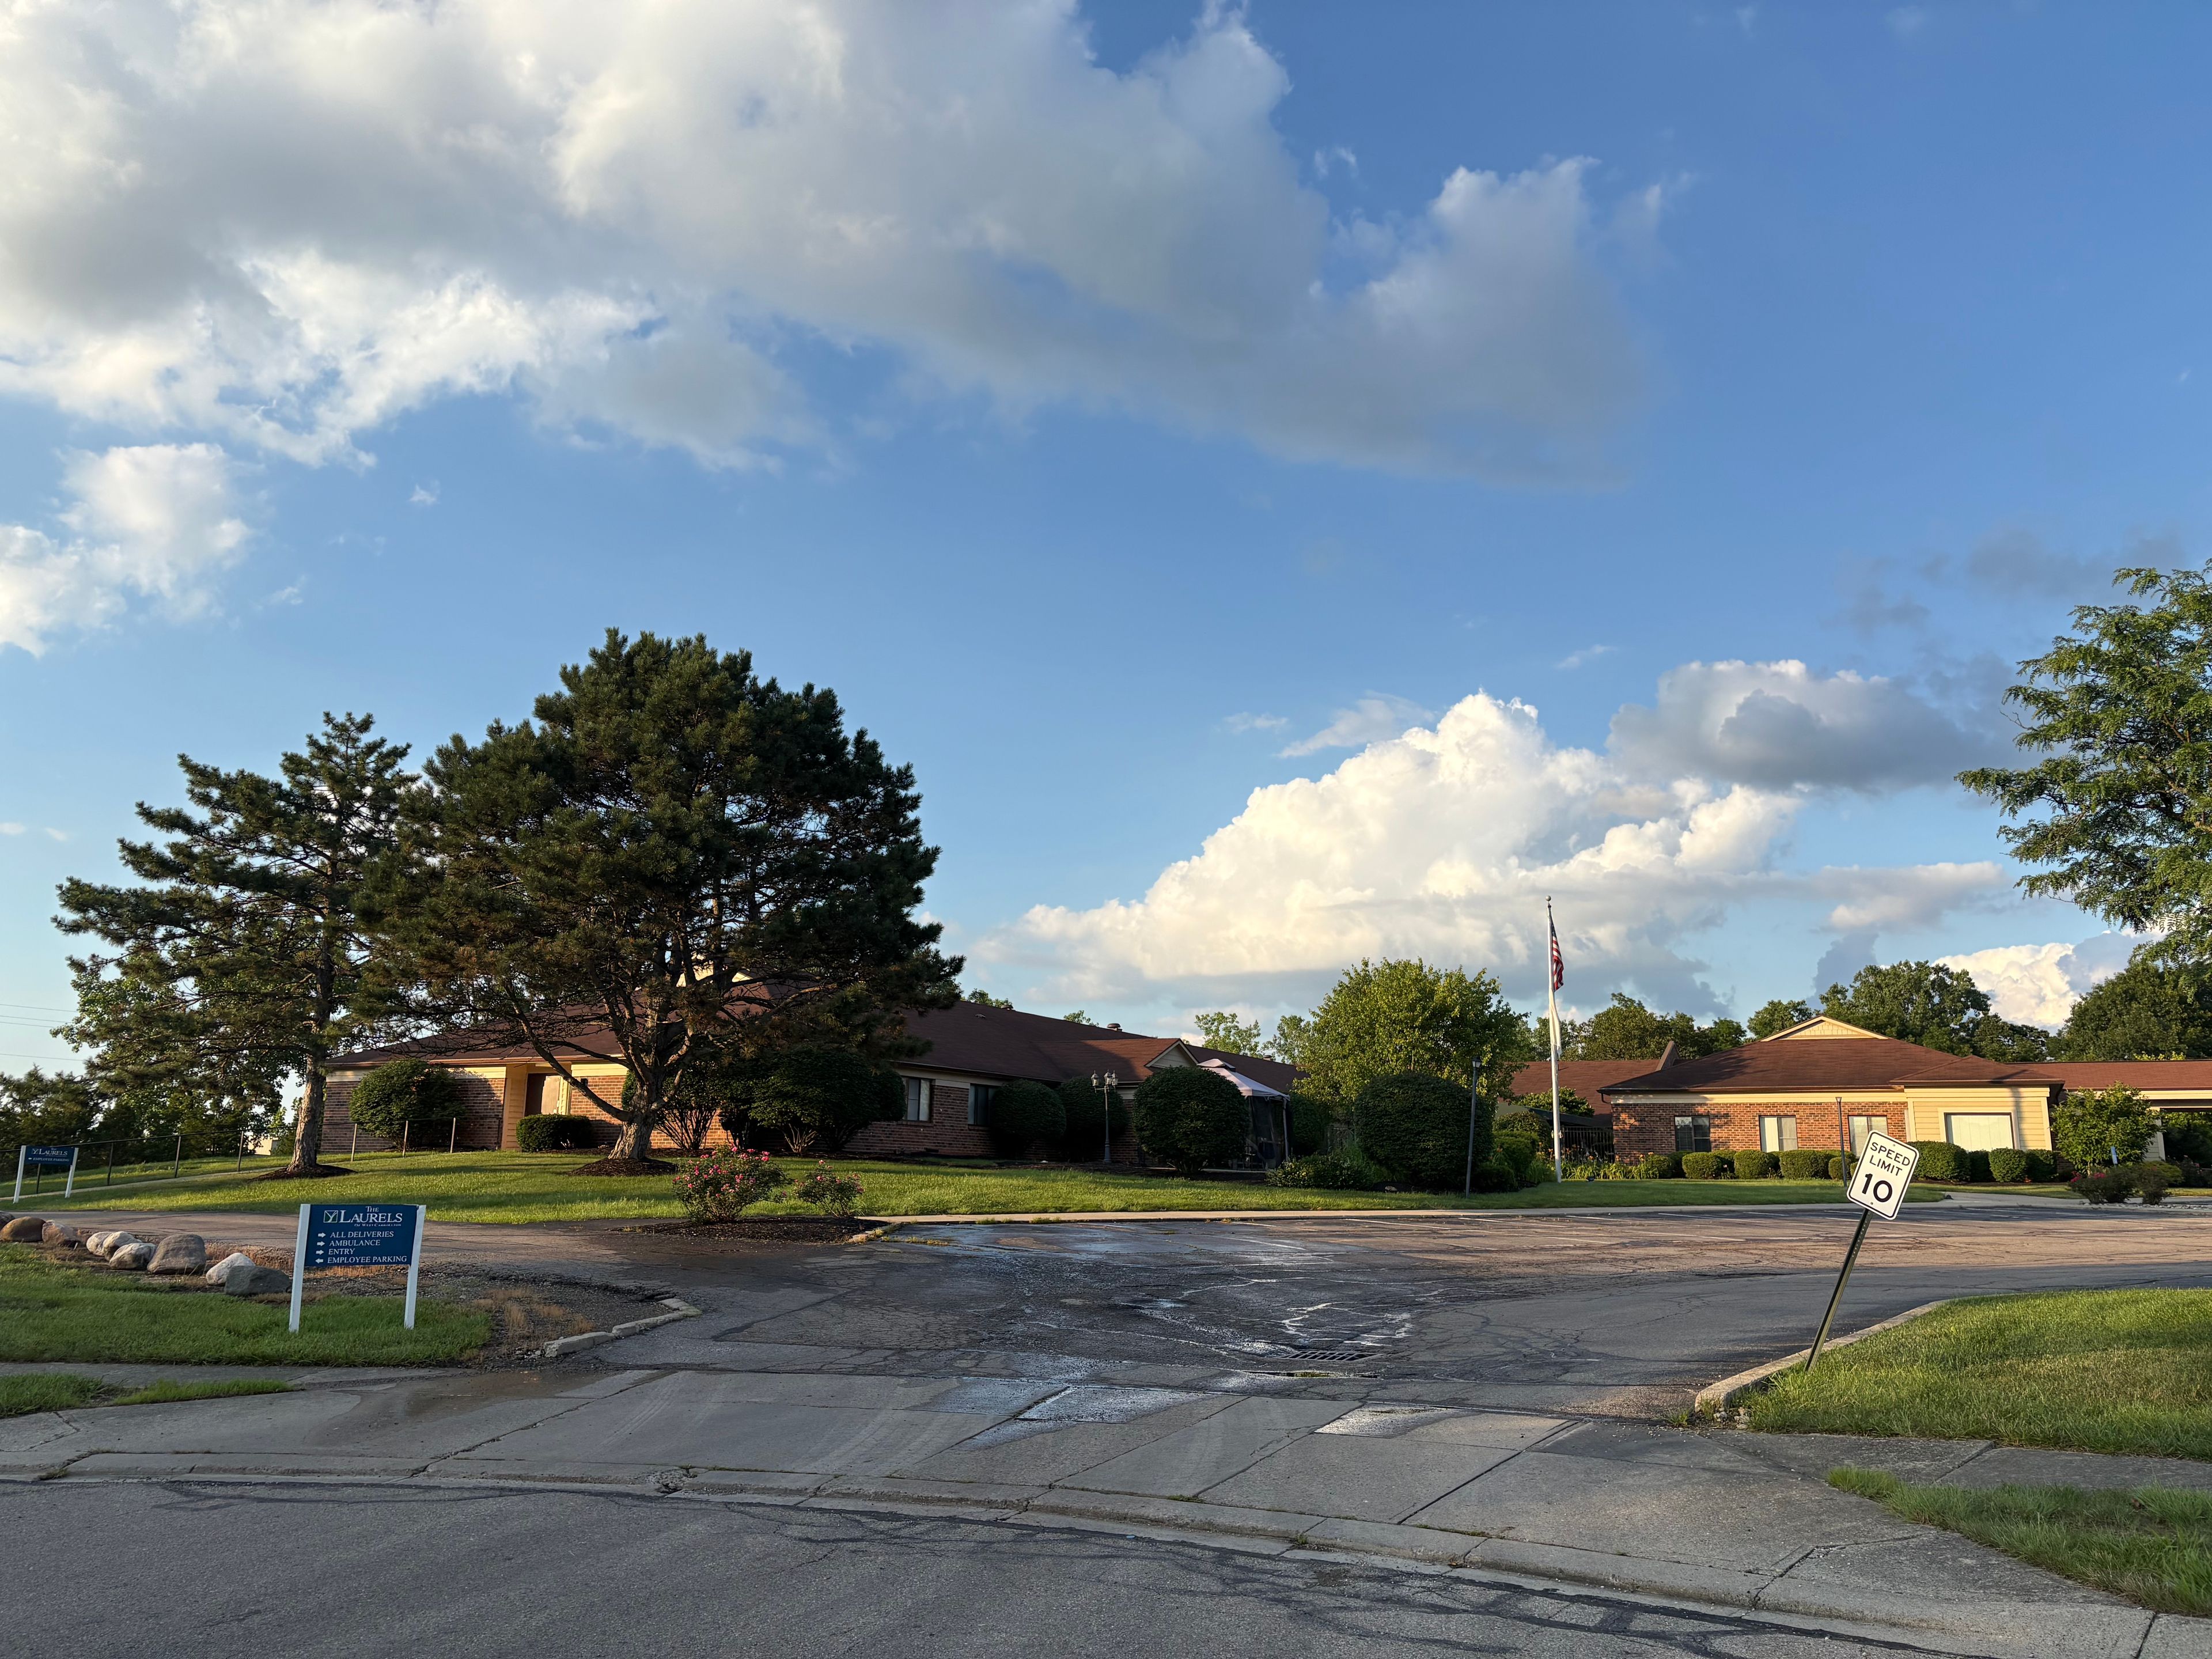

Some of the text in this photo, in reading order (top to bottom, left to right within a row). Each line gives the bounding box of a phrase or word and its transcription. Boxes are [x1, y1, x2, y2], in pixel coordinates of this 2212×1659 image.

[1869, 1154, 1903, 1176] LIMIT
[1870, 1142, 1910, 1166] SPEED
[1861, 1173, 1893, 1203] 10
[339, 1210, 403, 1223] LAURELS
